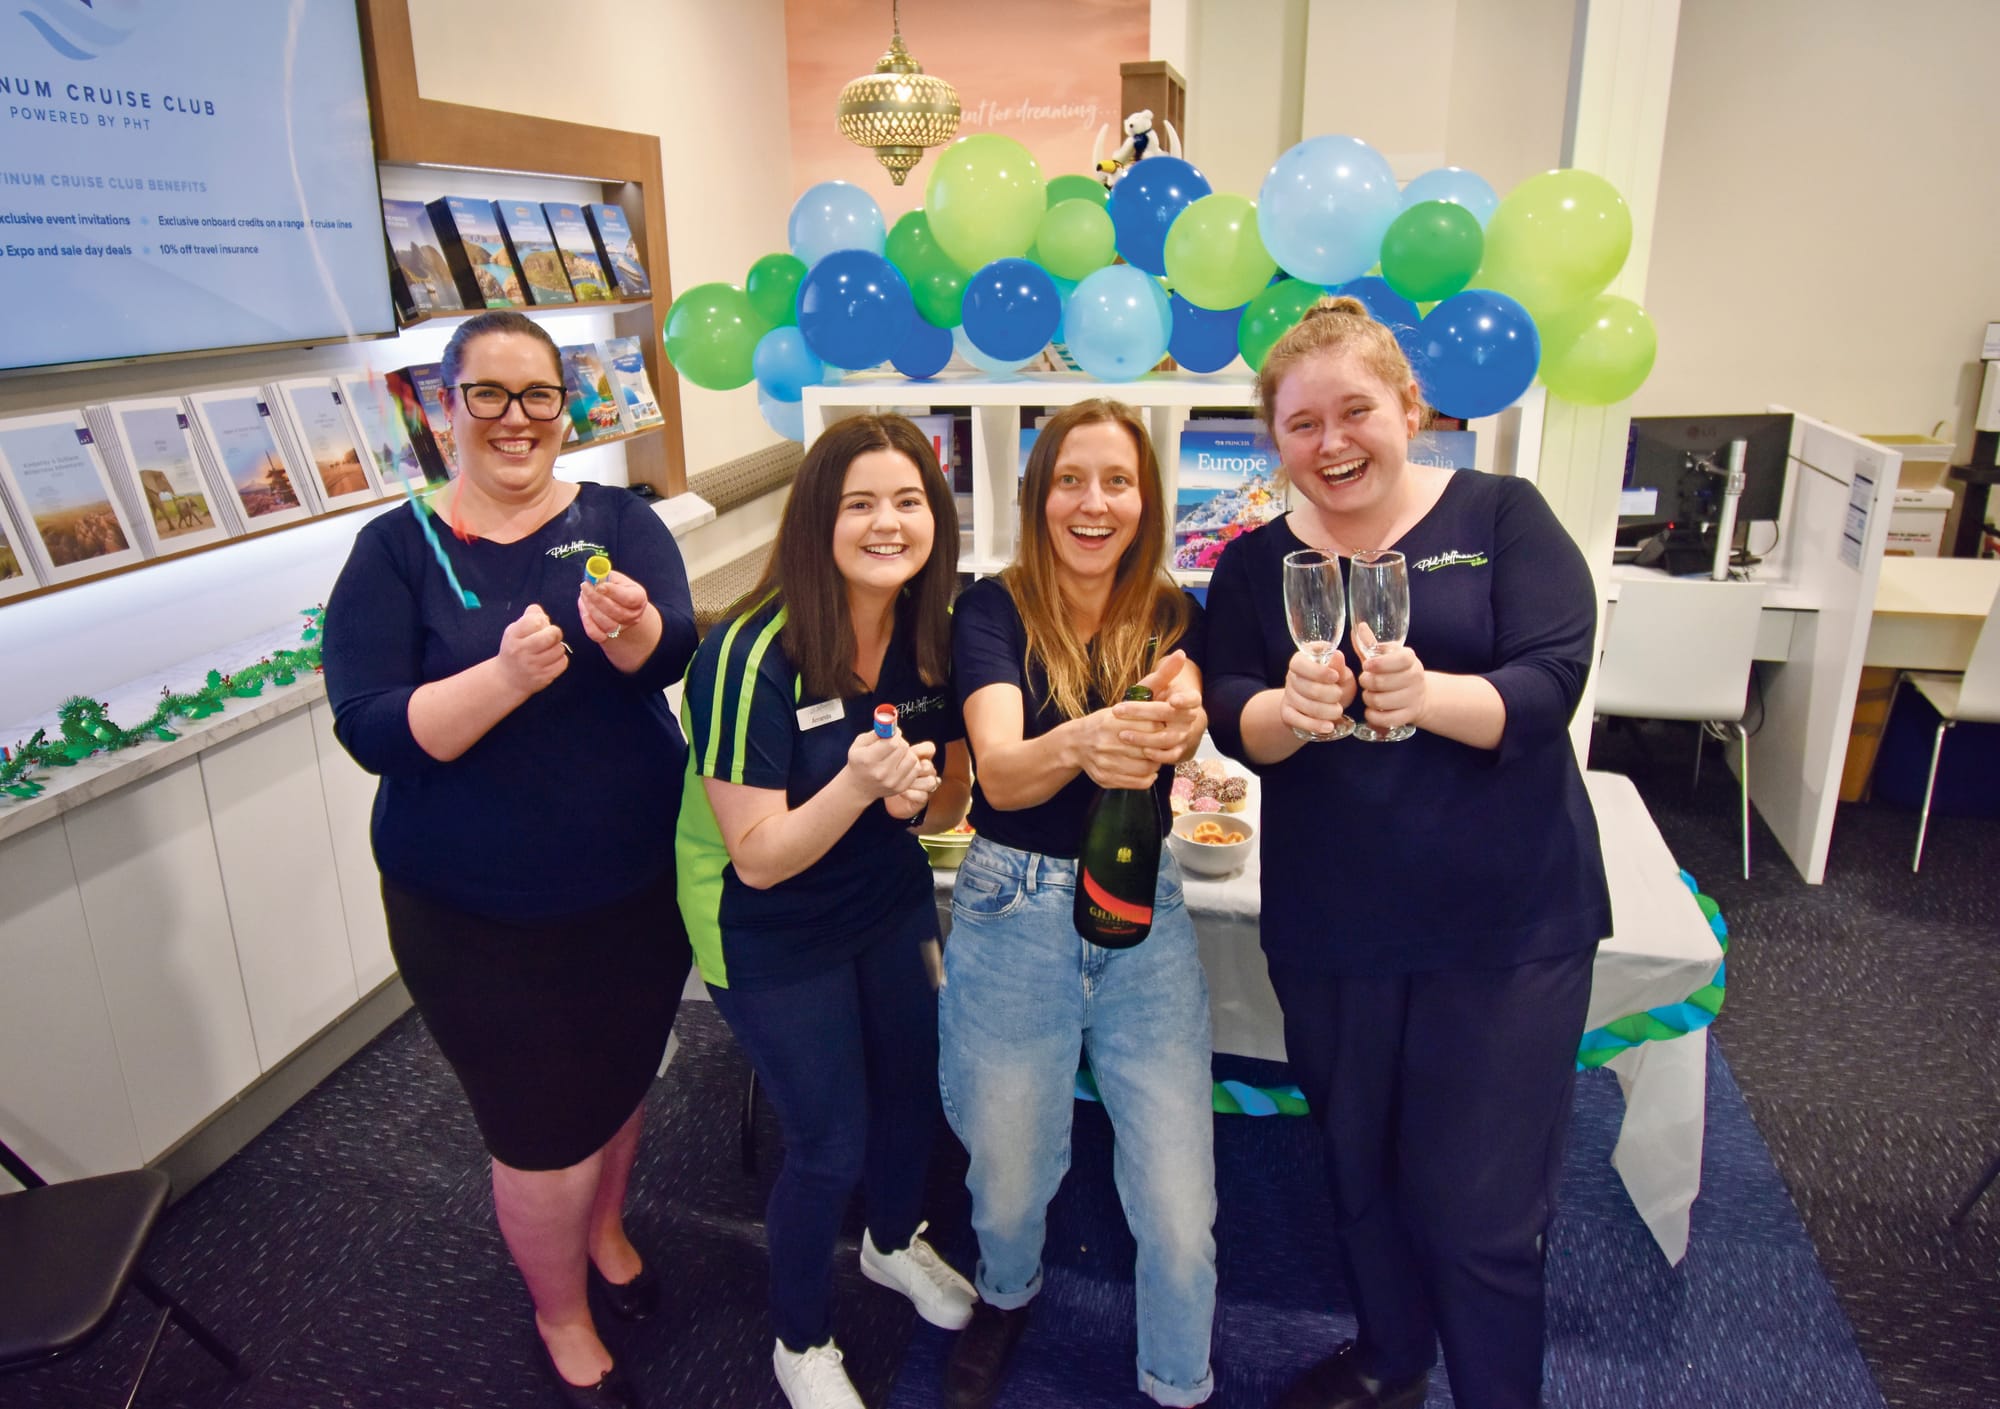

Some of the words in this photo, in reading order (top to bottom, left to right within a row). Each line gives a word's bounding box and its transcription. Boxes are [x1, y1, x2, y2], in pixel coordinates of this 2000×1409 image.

[66, 84, 151, 109] CRUISE
[163, 95, 215, 116] CLUB
[10, 106, 89, 125] POWERED
[99, 114, 115, 127] BY
[124, 117, 150, 130] PHT
[51, 174, 104, 189] CRUISE
[109, 177, 144, 190] CLUB
[148, 179, 207, 193] BENEFITS
[46, 215, 76, 225] event
[78, 213, 130, 226] invitations
[158, 216, 199, 227] Exclusive
[201, 217, 236, 228] onboard
[238, 217, 264, 228] credits
[266, 220, 276, 228] on
[284, 220, 305, 231] range
[315, 220, 336, 229] cruise
[337, 219, 353, 229] lines
[7, 246, 35, 259] Expo
[38, 245, 59, 257] and
[61, 245, 82, 256] sale
[85, 246, 104, 258] day
[106, 245, 132, 256] deals
[160, 244, 178, 255] 10%
[180, 244, 192, 255] off
[193, 243, 218, 255] travel
[220, 243, 259, 255] insurance
[1198, 453, 1267, 477] Europe
